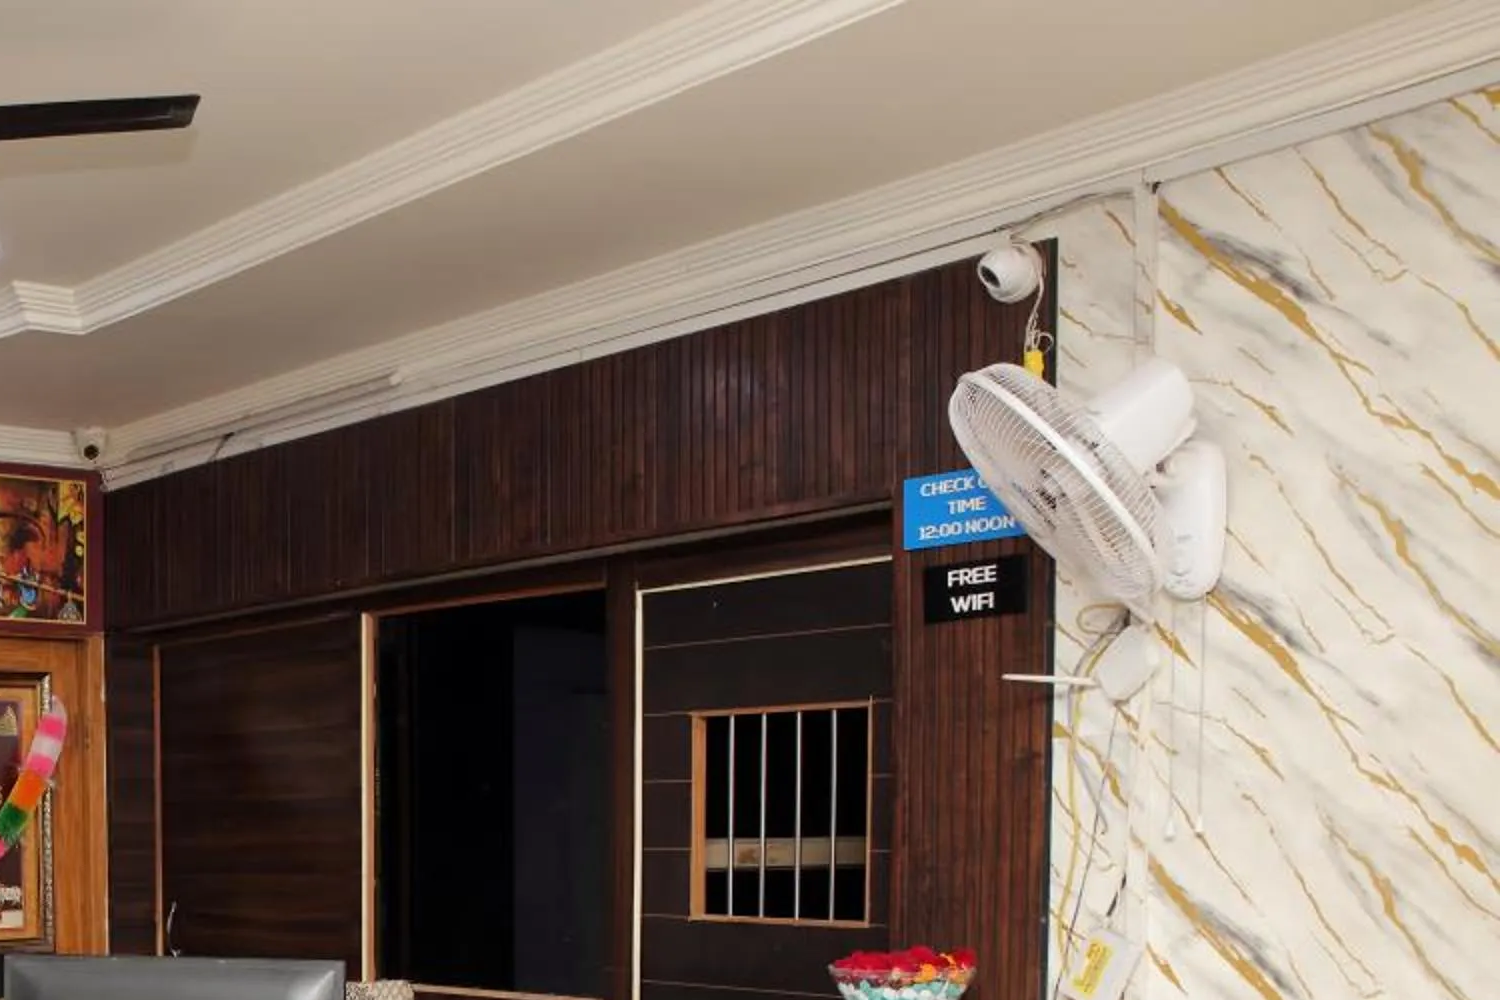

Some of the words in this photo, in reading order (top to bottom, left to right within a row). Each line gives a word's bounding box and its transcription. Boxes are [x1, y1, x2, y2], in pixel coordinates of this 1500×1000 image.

[920, 476, 975, 497] CHECK
[948, 496, 987, 515] TIME
[964, 515, 1016, 534] NOON
[947, 564, 997, 587] FREE
[950, 591, 995, 613] WIFI
